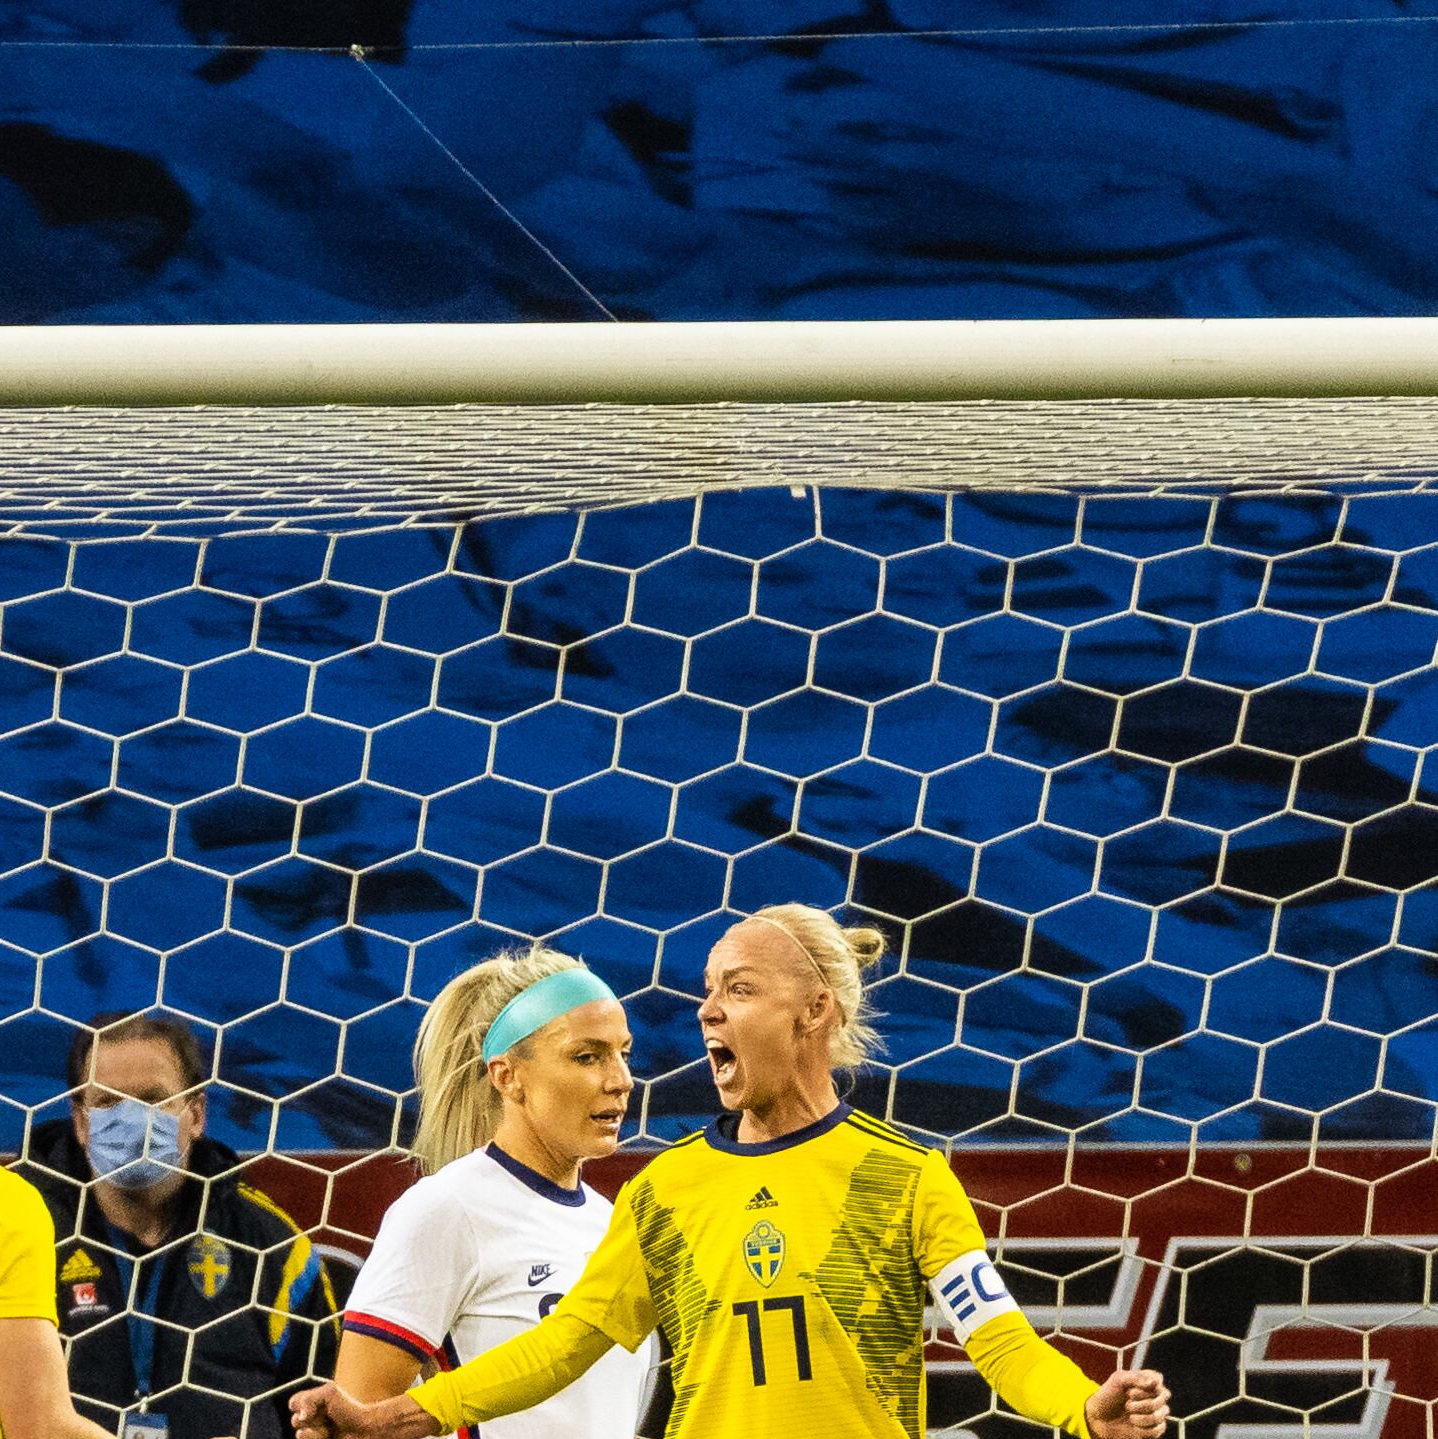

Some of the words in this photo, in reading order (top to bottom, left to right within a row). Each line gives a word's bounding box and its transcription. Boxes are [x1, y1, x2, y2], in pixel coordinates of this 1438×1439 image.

[745, 1199, 779, 1211] adidas
[531, 1263, 551, 1277] NIKE
[732, 1295, 813, 1387] 17
